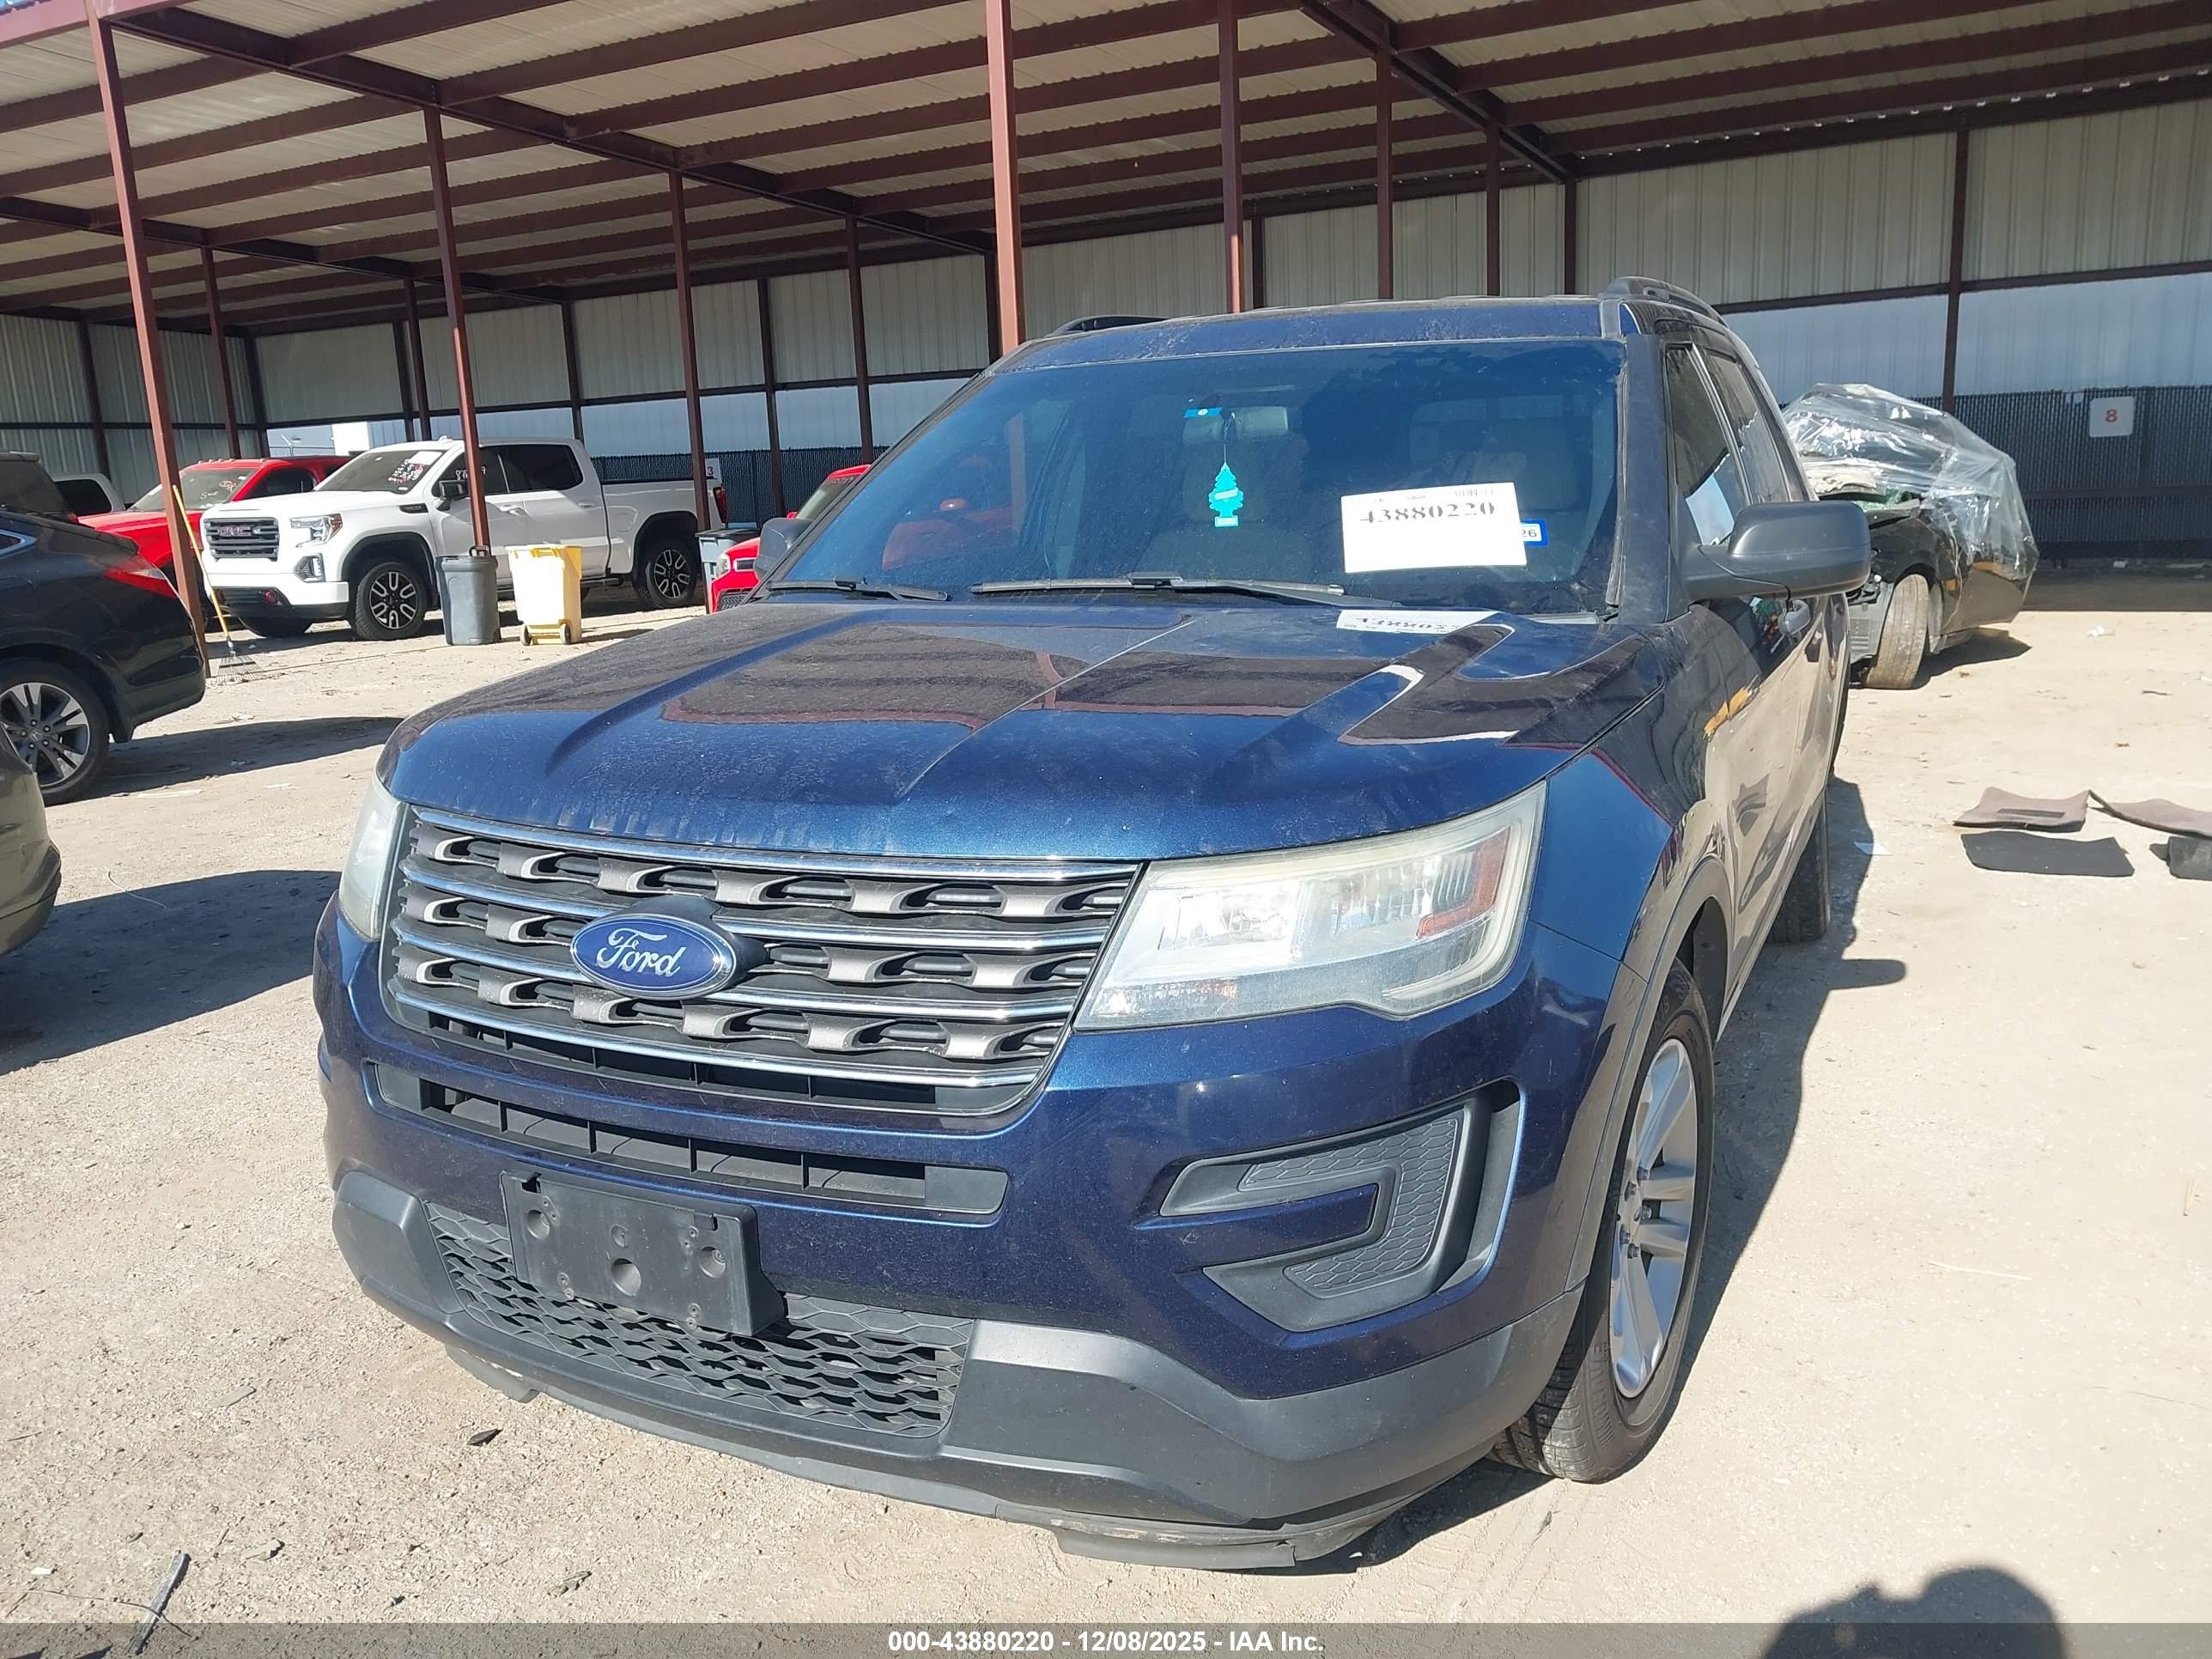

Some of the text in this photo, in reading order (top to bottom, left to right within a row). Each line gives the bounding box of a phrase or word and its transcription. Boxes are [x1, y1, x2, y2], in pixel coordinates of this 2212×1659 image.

[2106, 409, 2118, 422] 8
[1361, 501, 1495, 524] 43880220
[596, 927, 686, 976] Ford
